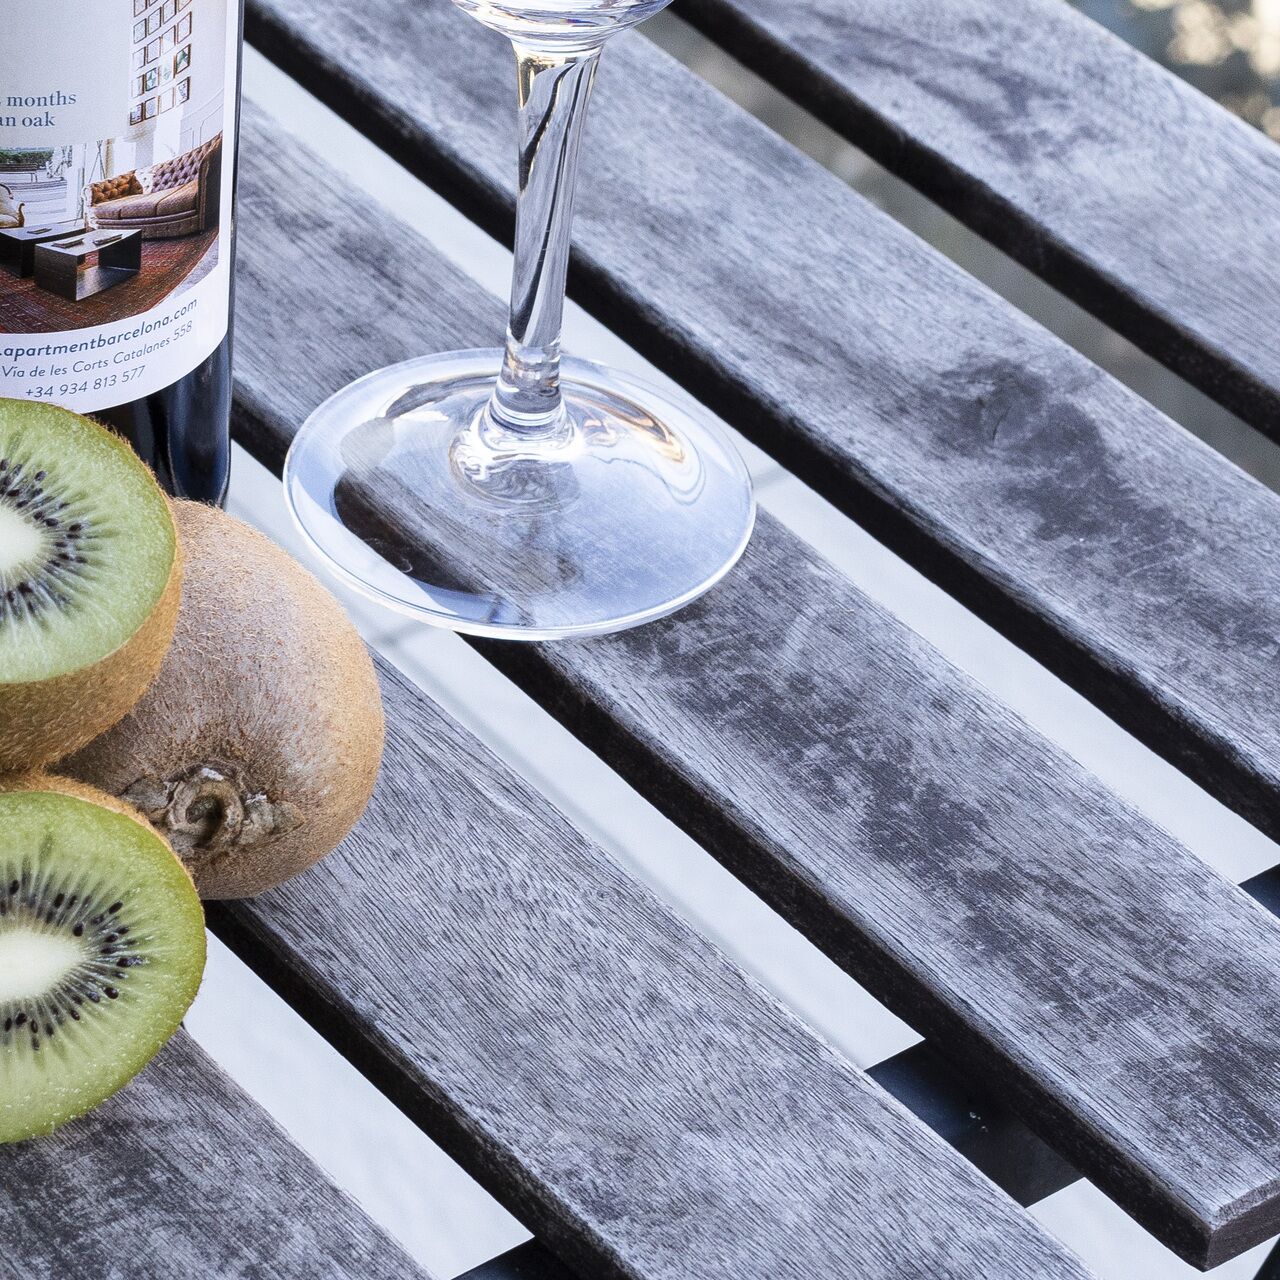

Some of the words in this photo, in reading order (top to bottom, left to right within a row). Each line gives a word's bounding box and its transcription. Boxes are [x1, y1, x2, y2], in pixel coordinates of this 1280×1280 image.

[7, 91, 77, 107] months
[21, 111, 56, 127] oak
[2, 365, 25, 377] Vía
[29, 365, 46, 377] de
[50, 364, 67, 376] les
[73, 359, 109, 373] Corts
[113, 337, 171, 364] Catalanes
[173, 320, 193, 341] 558
[26, 385, 53, 398] +34
[60, 380, 88, 396] 934
[93, 374, 117, 390] 813
[122, 365, 146, 383] 577
